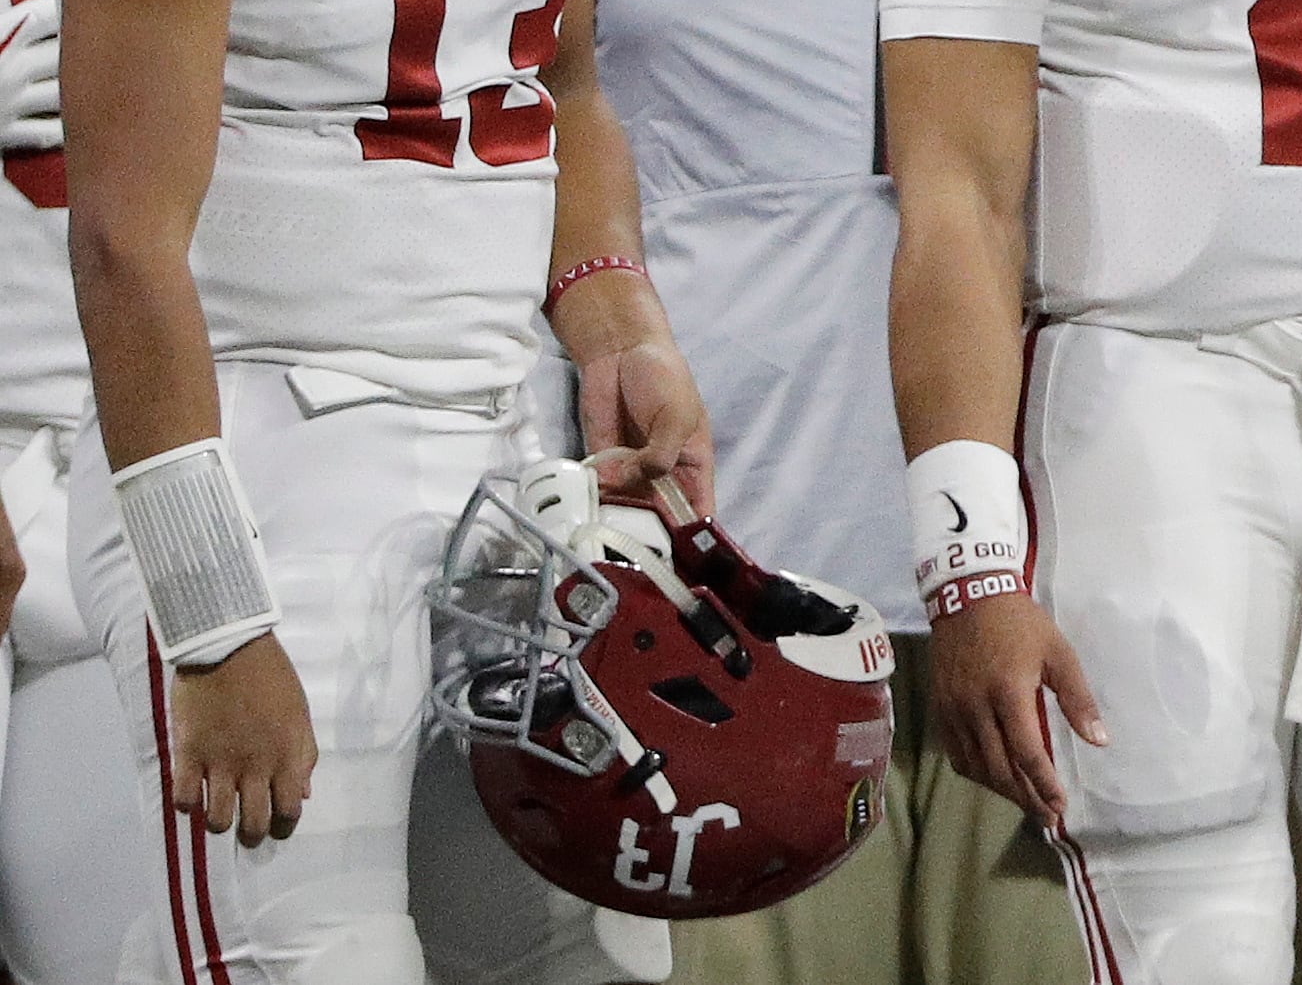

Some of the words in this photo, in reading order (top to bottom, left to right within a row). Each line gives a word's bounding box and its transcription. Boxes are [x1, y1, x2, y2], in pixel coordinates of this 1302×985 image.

[947, 543, 966, 569] 2
[975, 542, 1016, 560] GOD
[942, 583, 963, 614] 2
[966, 574, 1017, 600] GOD
